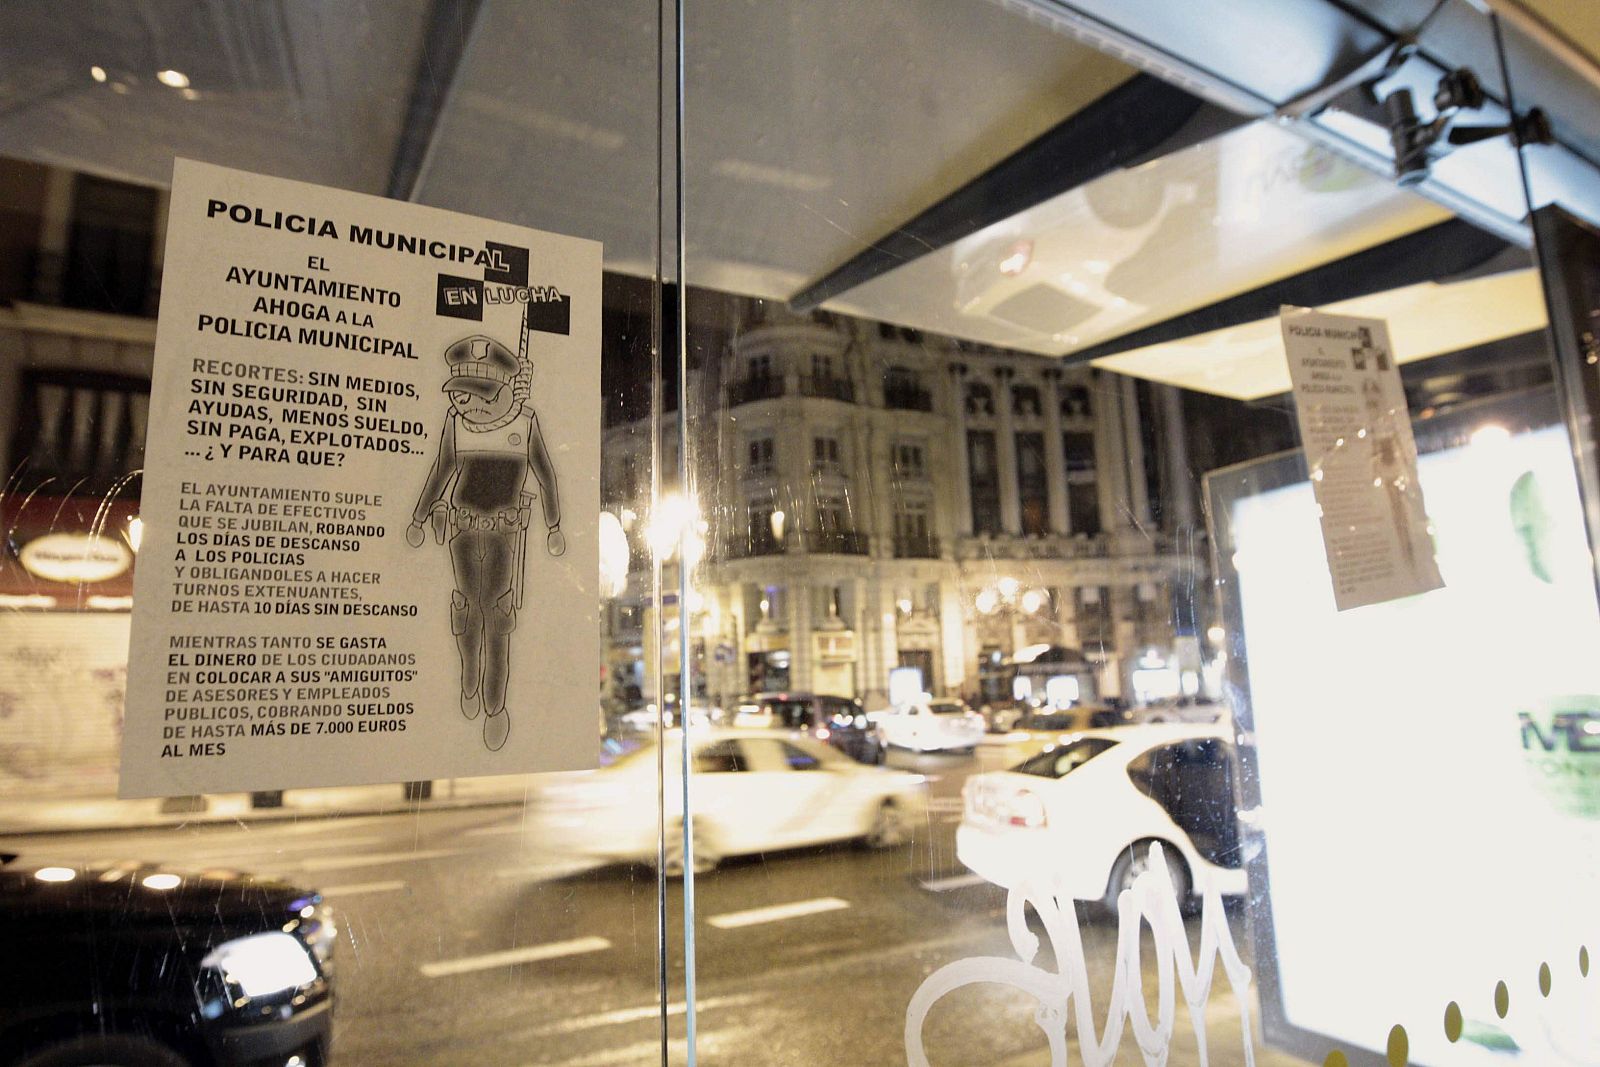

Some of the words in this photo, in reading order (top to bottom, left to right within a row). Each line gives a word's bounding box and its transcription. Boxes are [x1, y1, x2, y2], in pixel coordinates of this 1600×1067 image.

[207, 199, 338, 239] POLICIA
[350, 224, 510, 272] MUNICIPAL
[308, 256, 330, 272] EL
[226, 266, 400, 308] AYUNTAMIENTO
[443, 286, 478, 306] EN
[484, 285, 563, 305] LUCHA
[252, 297, 330, 322] AHOGA
[336, 310, 347, 324] A
[352, 312, 374, 328] LA
[198, 315, 292, 343] POLICIA
[298, 328, 418, 360] MUNICIPAL
[193, 358, 303, 384] RECORTES:
[308, 372, 340, 388] SIN
[346, 376, 419, 400] MEDIOS,
[191, 379, 225, 396] SIN
[232, 383, 347, 411] SEGURIDAD,
[357, 396, 386, 413] SIN
[188, 400, 272, 424] AYUDAS,
[282, 408, 348, 428] MENOS
[354, 416, 427, 438] SUELDO,
[187, 420, 222, 437] SIN
[229, 424, 285, 446] PAGA,
[239, 445, 290, 463] PARA
[297, 450, 345, 467] QUE?
[181, 482, 201, 495] EL
[206, 484, 330, 502] AYUNTAMIENTO
[335, 492, 382, 506] SUPLE
[180, 498, 200, 511] LA
[206, 500, 252, 514] FALTA
[258, 504, 278, 515] DE
[283, 505, 366, 520] EFECTIVOS
[179, 515, 212, 528] QUE
[218, 518, 237, 530] SE
[241, 519, 312, 535] JUBILAN,
[316, 522, 384, 538] ROBANDO
[177, 532, 208, 545] LOS
[213, 533, 250, 547] DÍAS
[256, 536, 276, 548] DE
[281, 537, 360, 552] DESCANSO
[175, 549, 186, 561] A
[196, 550, 226, 562] LOS
[232, 551, 304, 566] POLICIAS
[174, 566, 185, 578] Y
[190, 567, 312, 582] OBLIGANDOLES
[316, 571, 326, 582] A
[332, 571, 380, 584] HACER
[173, 583, 239, 596] TURNOS
[245, 585, 362, 601] EXTENUANTES,
[172, 600, 193, 612] DE
[198, 601, 250, 613] HASTA
[254, 602, 271, 614] 10
[275, 601, 310, 615] DÍAS
[314, 603, 338, 615] SIN
[343, 604, 417, 616] DESCANSO
[170, 636, 256, 648] MIENTRAS
[261, 636, 311, 648] TANTO
[316, 637, 335, 649] SE
[340, 637, 386, 649] GASTA
[168, 654, 189, 666] EL
[195, 654, 256, 666] DINERO
[262, 654, 282, 666] DE
[288, 654, 316, 666] LOS
[322, 654, 416, 665] CIUDADANOS
[167, 672, 190, 684] EN
[196, 671, 271, 684] COLOCAR
[275, 671, 285, 683] A
[291, 671, 320, 683] SUS
[324, 670, 418, 682] "AMIGUITOS"
[166, 690, 188, 702] DE
[192, 688, 278, 702] ASESORES
[283, 688, 292, 700] Y
[297, 687, 390, 700] EMPLEADOS
[165, 706, 253, 720] PUBLICOS,
[258, 704, 342, 718] COBRANDO
[347, 702, 414, 716] SUELDOS
[163, 726, 185, 739] DE
[192, 724, 245, 738] HASTA
[251, 721, 286, 736] MÁS
[290, 722, 311, 735] DE
[316, 721, 353, 734] 7.000
[358, 719, 406, 732] EUROS
[161, 744, 183, 758] AL
[189, 742, 225, 756] MES
